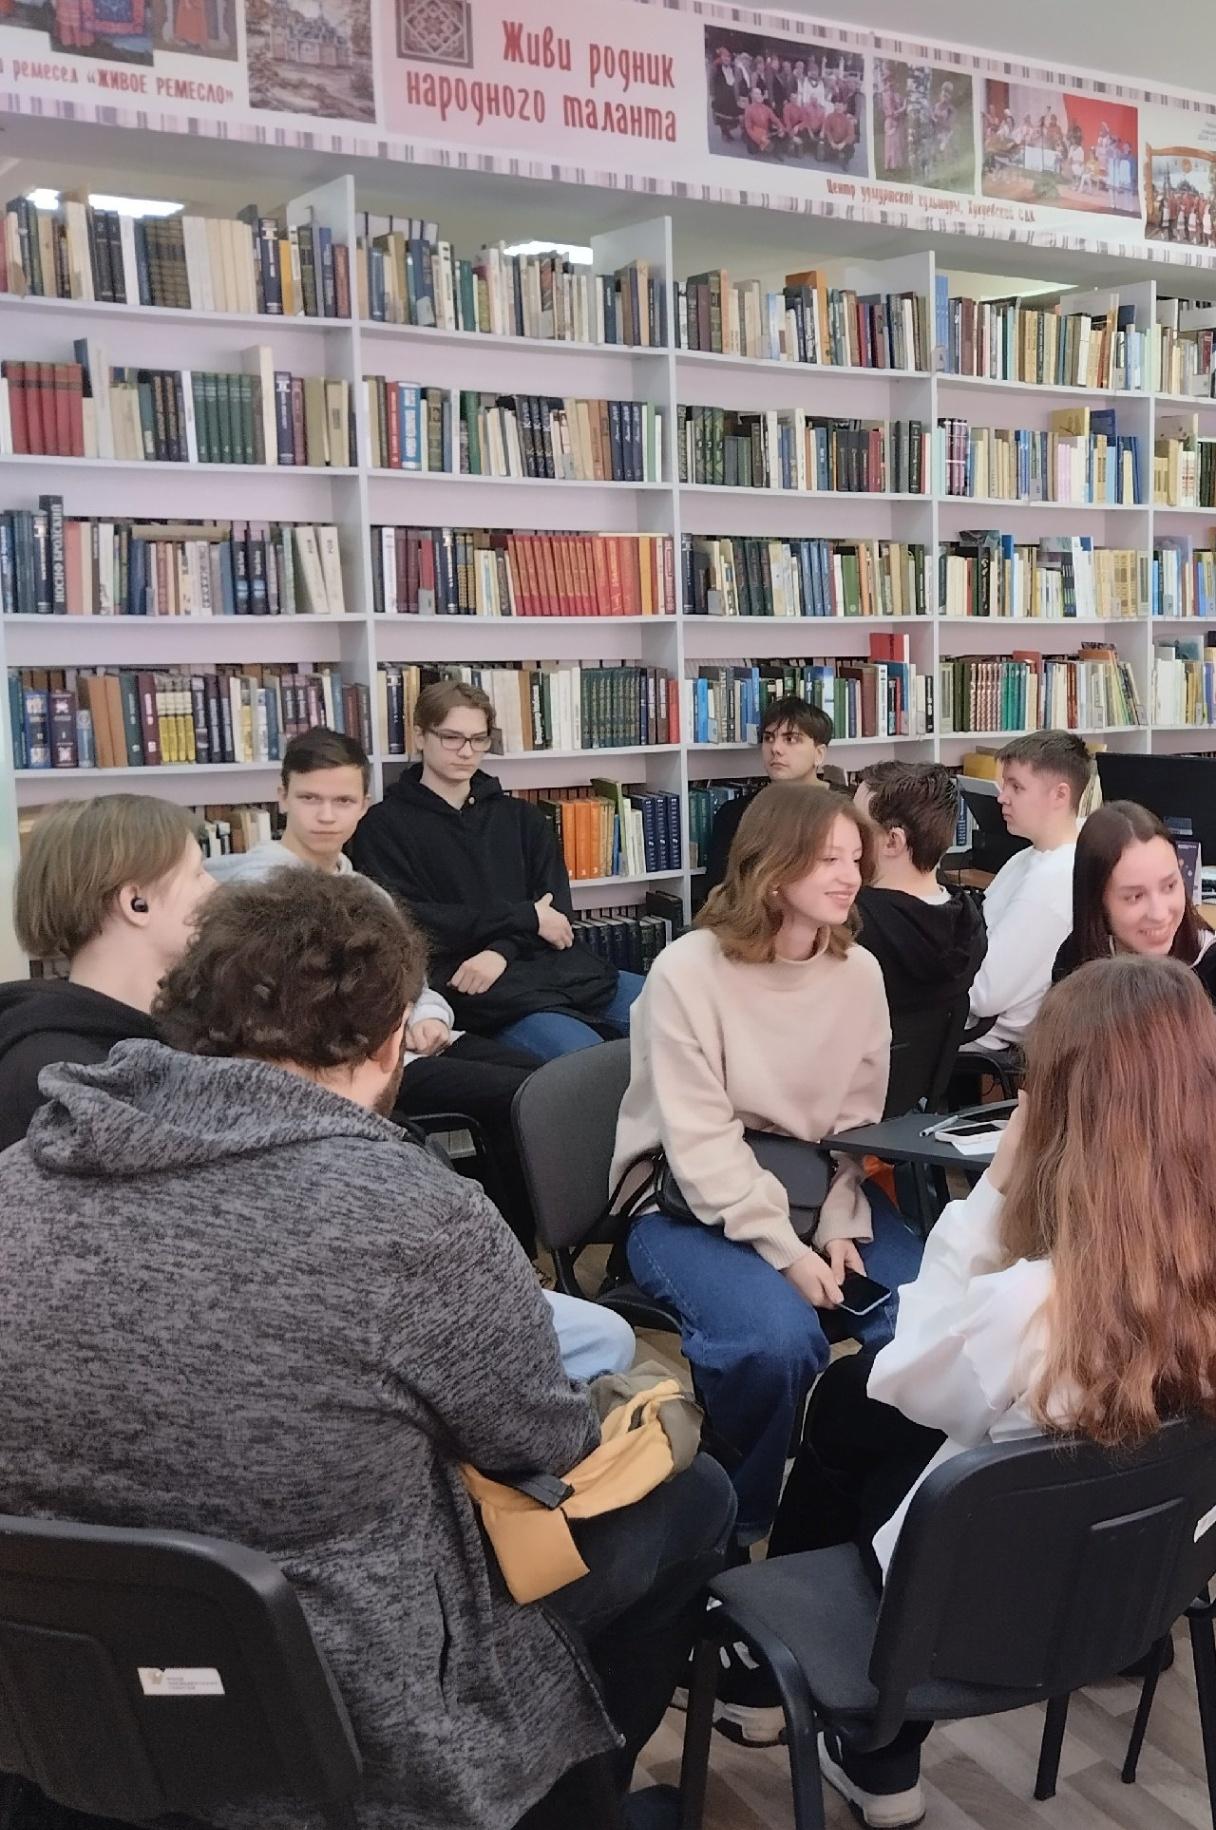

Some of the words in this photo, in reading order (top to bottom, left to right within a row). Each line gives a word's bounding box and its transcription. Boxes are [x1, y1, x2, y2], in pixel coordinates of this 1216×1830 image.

[13, 59, 79, 83] ремесел
[502, 20, 572, 71] Живи
[589, 43, 676, 93] родник
[406, 70, 546, 126] народного
[563, 94, 677, 143] таланта
